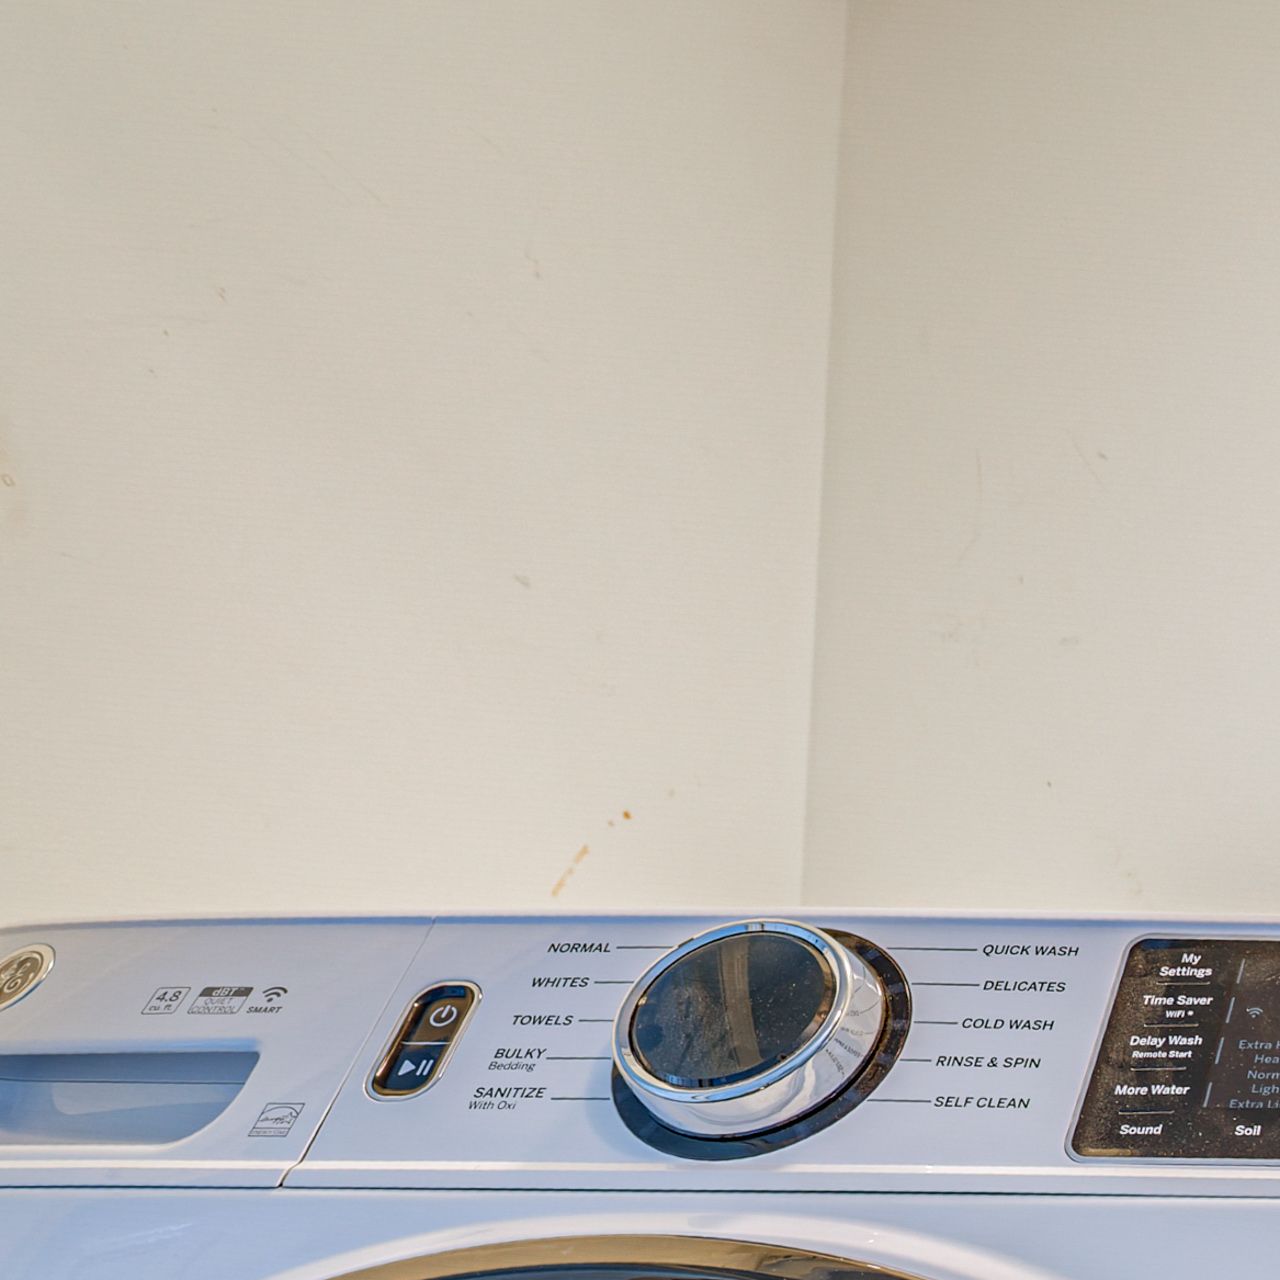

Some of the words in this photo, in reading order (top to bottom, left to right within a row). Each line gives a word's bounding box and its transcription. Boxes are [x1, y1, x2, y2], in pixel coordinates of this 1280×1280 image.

[548, 943, 611, 953] NORMAL
[982, 945, 1032, 956] QUICK
[1035, 946, 1079, 957] WASH
[1181, 953, 1201, 965] My
[1160, 966, 1213, 978] Settings
[532, 978, 590, 988] WHITES
[983, 981, 1066, 992] DELICATES
[156, 990, 182, 1002] 4.8
[1144, 995, 1174, 1006] Time
[1177, 995, 1213, 1006] Saver
[512, 1016, 574, 1026] TOWELS
[962, 1018, 1005, 1030] COLD
[1009, 1020, 1055, 1031] WASH
[1130, 1035, 1166, 1048] Delay
[1168, 1035, 1203, 1046] Wash
[1239, 1040, 1272, 1050] Extra
[494, 1049, 547, 1059] BULKY
[1132, 1050, 1167, 1059] Remote
[1168, 1050, 1192, 1059] Start
[488, 1062, 536, 1073] Bedding
[936, 1056, 984, 1067] RINSE
[987, 1057, 999, 1068] &
[1003, 1058, 1041, 1069] SPIN
[474, 1088, 547, 1099] SANITIZE
[1115, 1085, 1148, 1096] More
[1151, 1085, 1190, 1096] Water
[468, 1101, 494, 1110] With
[497, 1101, 516, 1111] Oxi
[934, 1097, 973, 1108] SELF
[977, 1098, 1030, 1109] CLEAN
[1229, 1099, 1264, 1109] Extra
[1120, 1125, 1163, 1136] Sound
[1235, 1125, 1262, 1136] Soil
